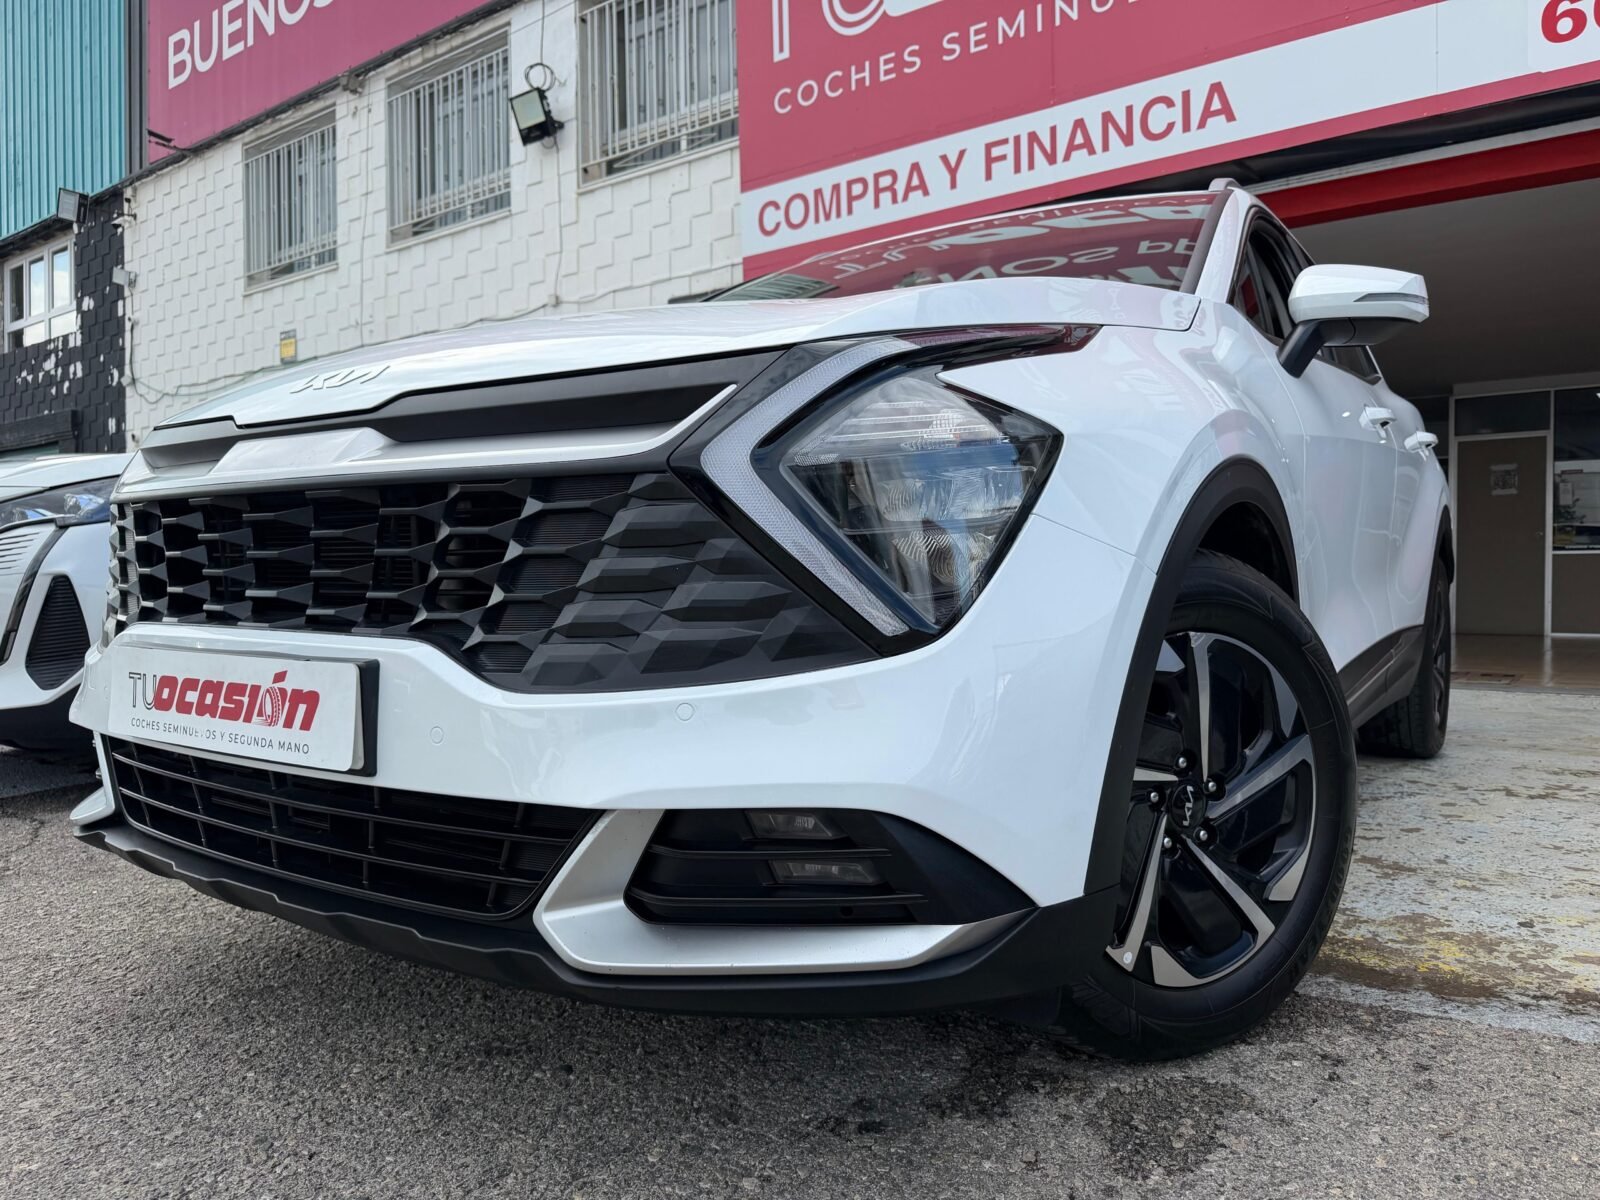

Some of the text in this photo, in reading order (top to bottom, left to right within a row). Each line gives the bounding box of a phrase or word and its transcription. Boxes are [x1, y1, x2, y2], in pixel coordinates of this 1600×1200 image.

[168, 0, 334, 90] BUEN
[773, 45, 922, 114] COCHES
[942, 0, 1139, 61] SEMIN
[1541, 0, 1600, 43] 6
[758, 81, 1237, 237] COMPRA Y FINANCIA
[131, 717, 310, 755] COCHES SEMINUEOS Y SEGUNDA MANO
